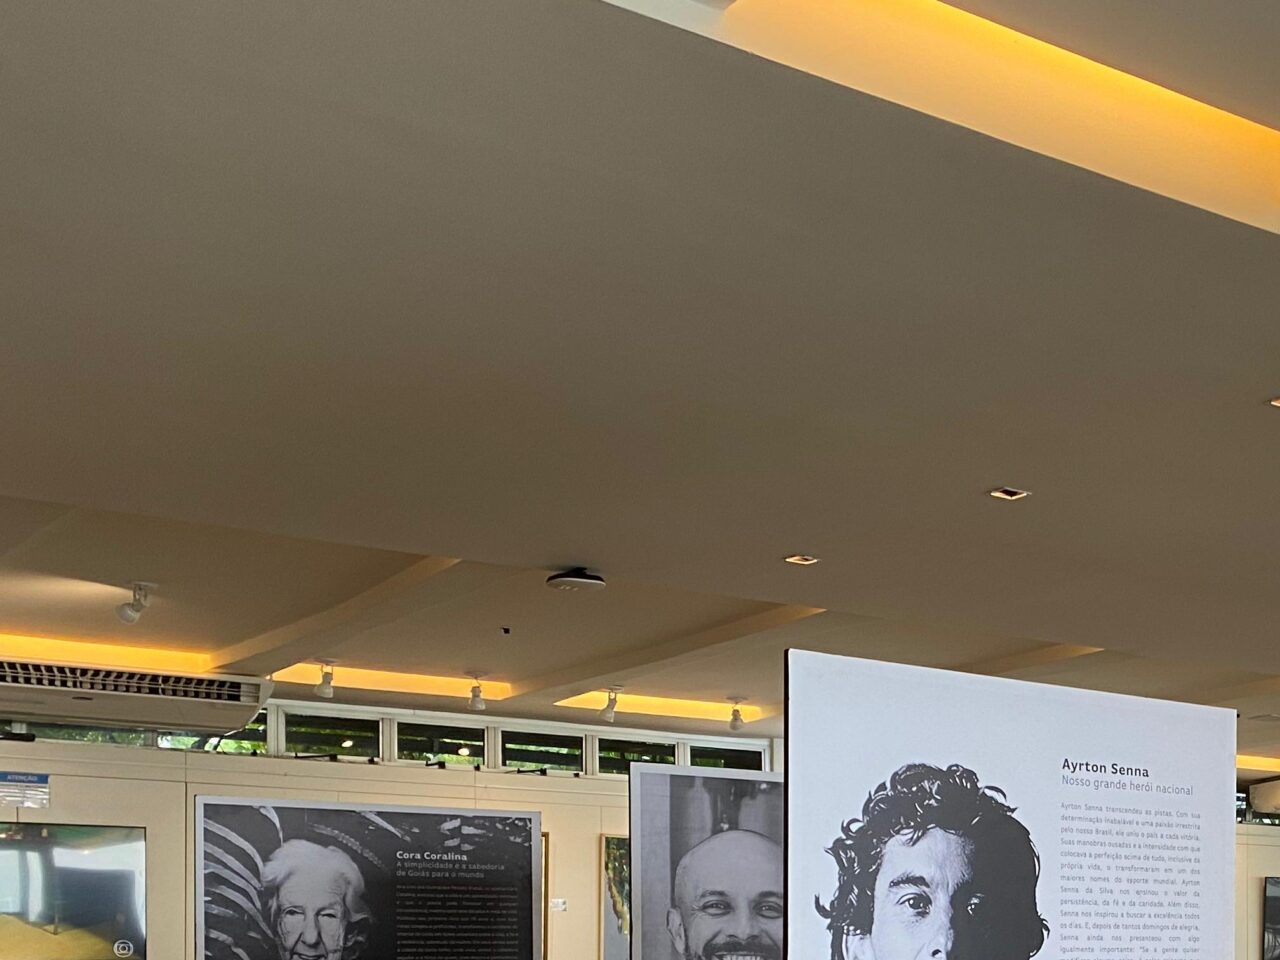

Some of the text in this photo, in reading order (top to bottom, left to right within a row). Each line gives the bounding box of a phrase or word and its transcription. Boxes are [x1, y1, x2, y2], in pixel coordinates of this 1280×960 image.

[1062, 758, 1150, 778] Ayrton Senna
[1062, 775, 1193, 796] Nosso grande herói nacional
[396, 851, 468, 861] Cora Coralina
[404, 862, 453, 870] simplicidade
